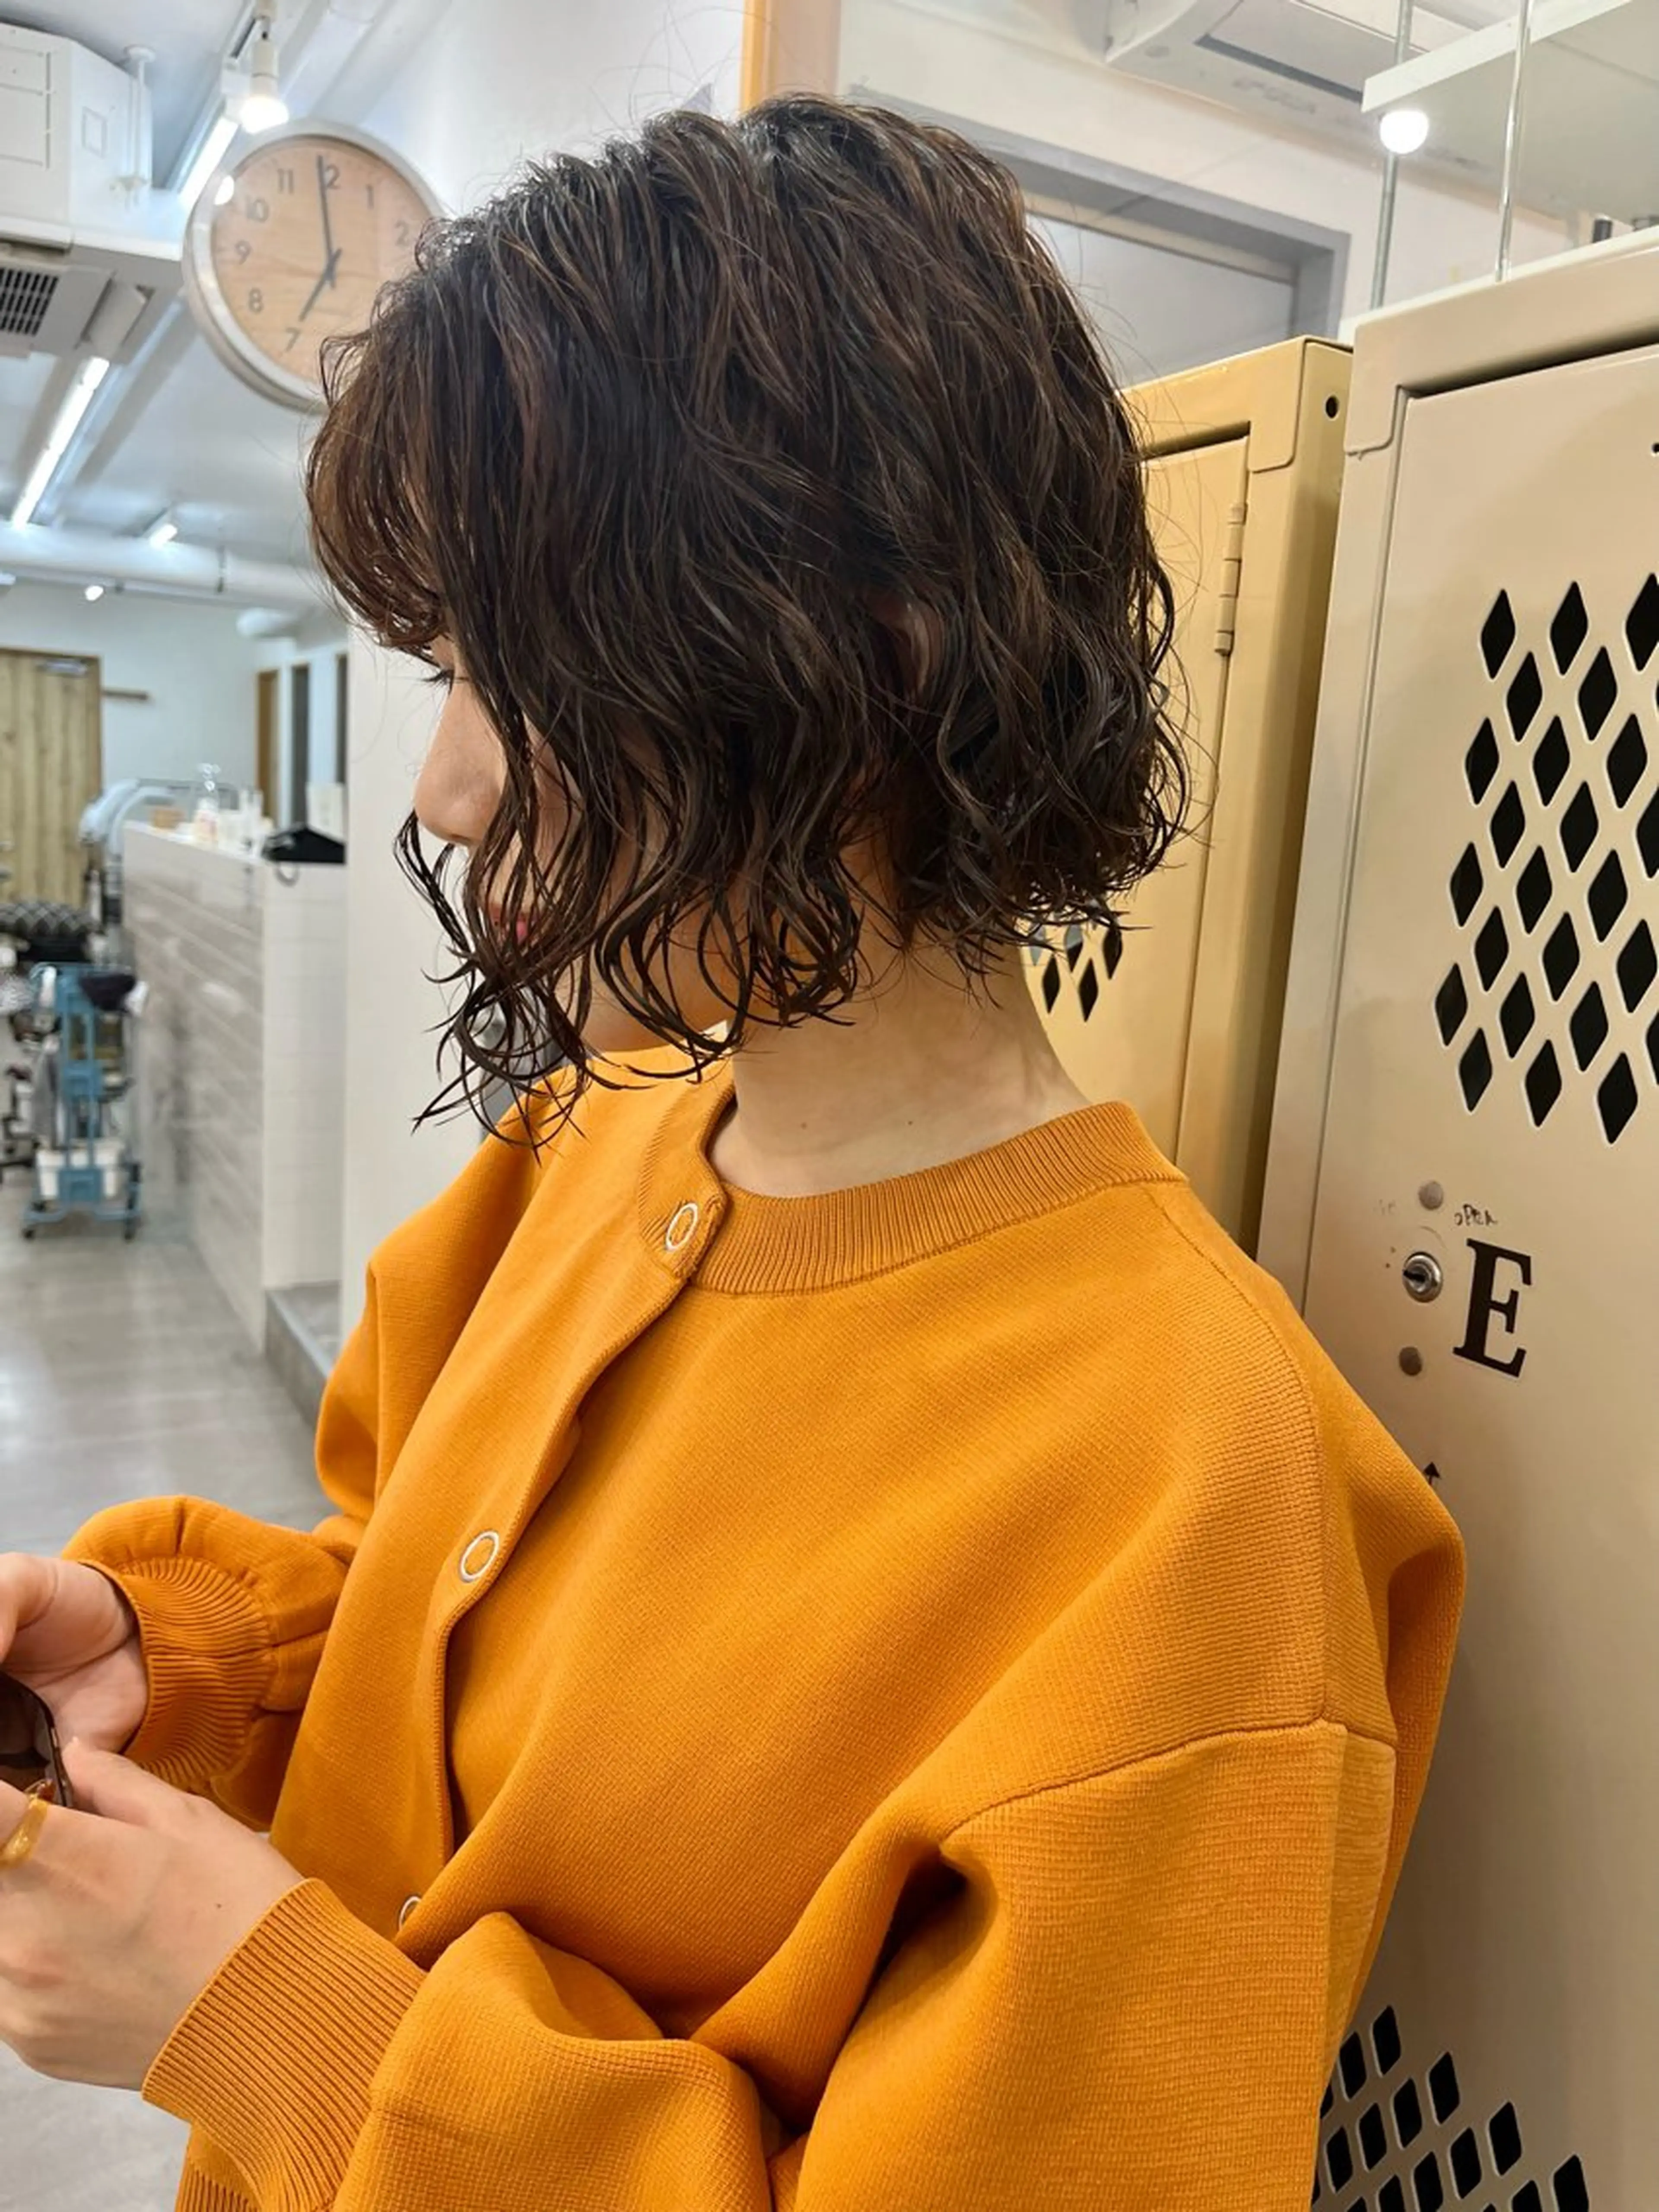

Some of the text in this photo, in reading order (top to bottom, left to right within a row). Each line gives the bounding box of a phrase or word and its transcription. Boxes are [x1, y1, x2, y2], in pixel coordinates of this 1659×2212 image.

[277, 168, 294, 195] 11
[245, 196, 270, 223] 10
[366, 184, 374, 210] 1
[394, 220, 409, 247] 2
[235, 240, 253, 265] 9
[248, 287, 264, 314] 8
[285, 327, 302, 352] 7
[1452, 1238, 1532, 1377] E
